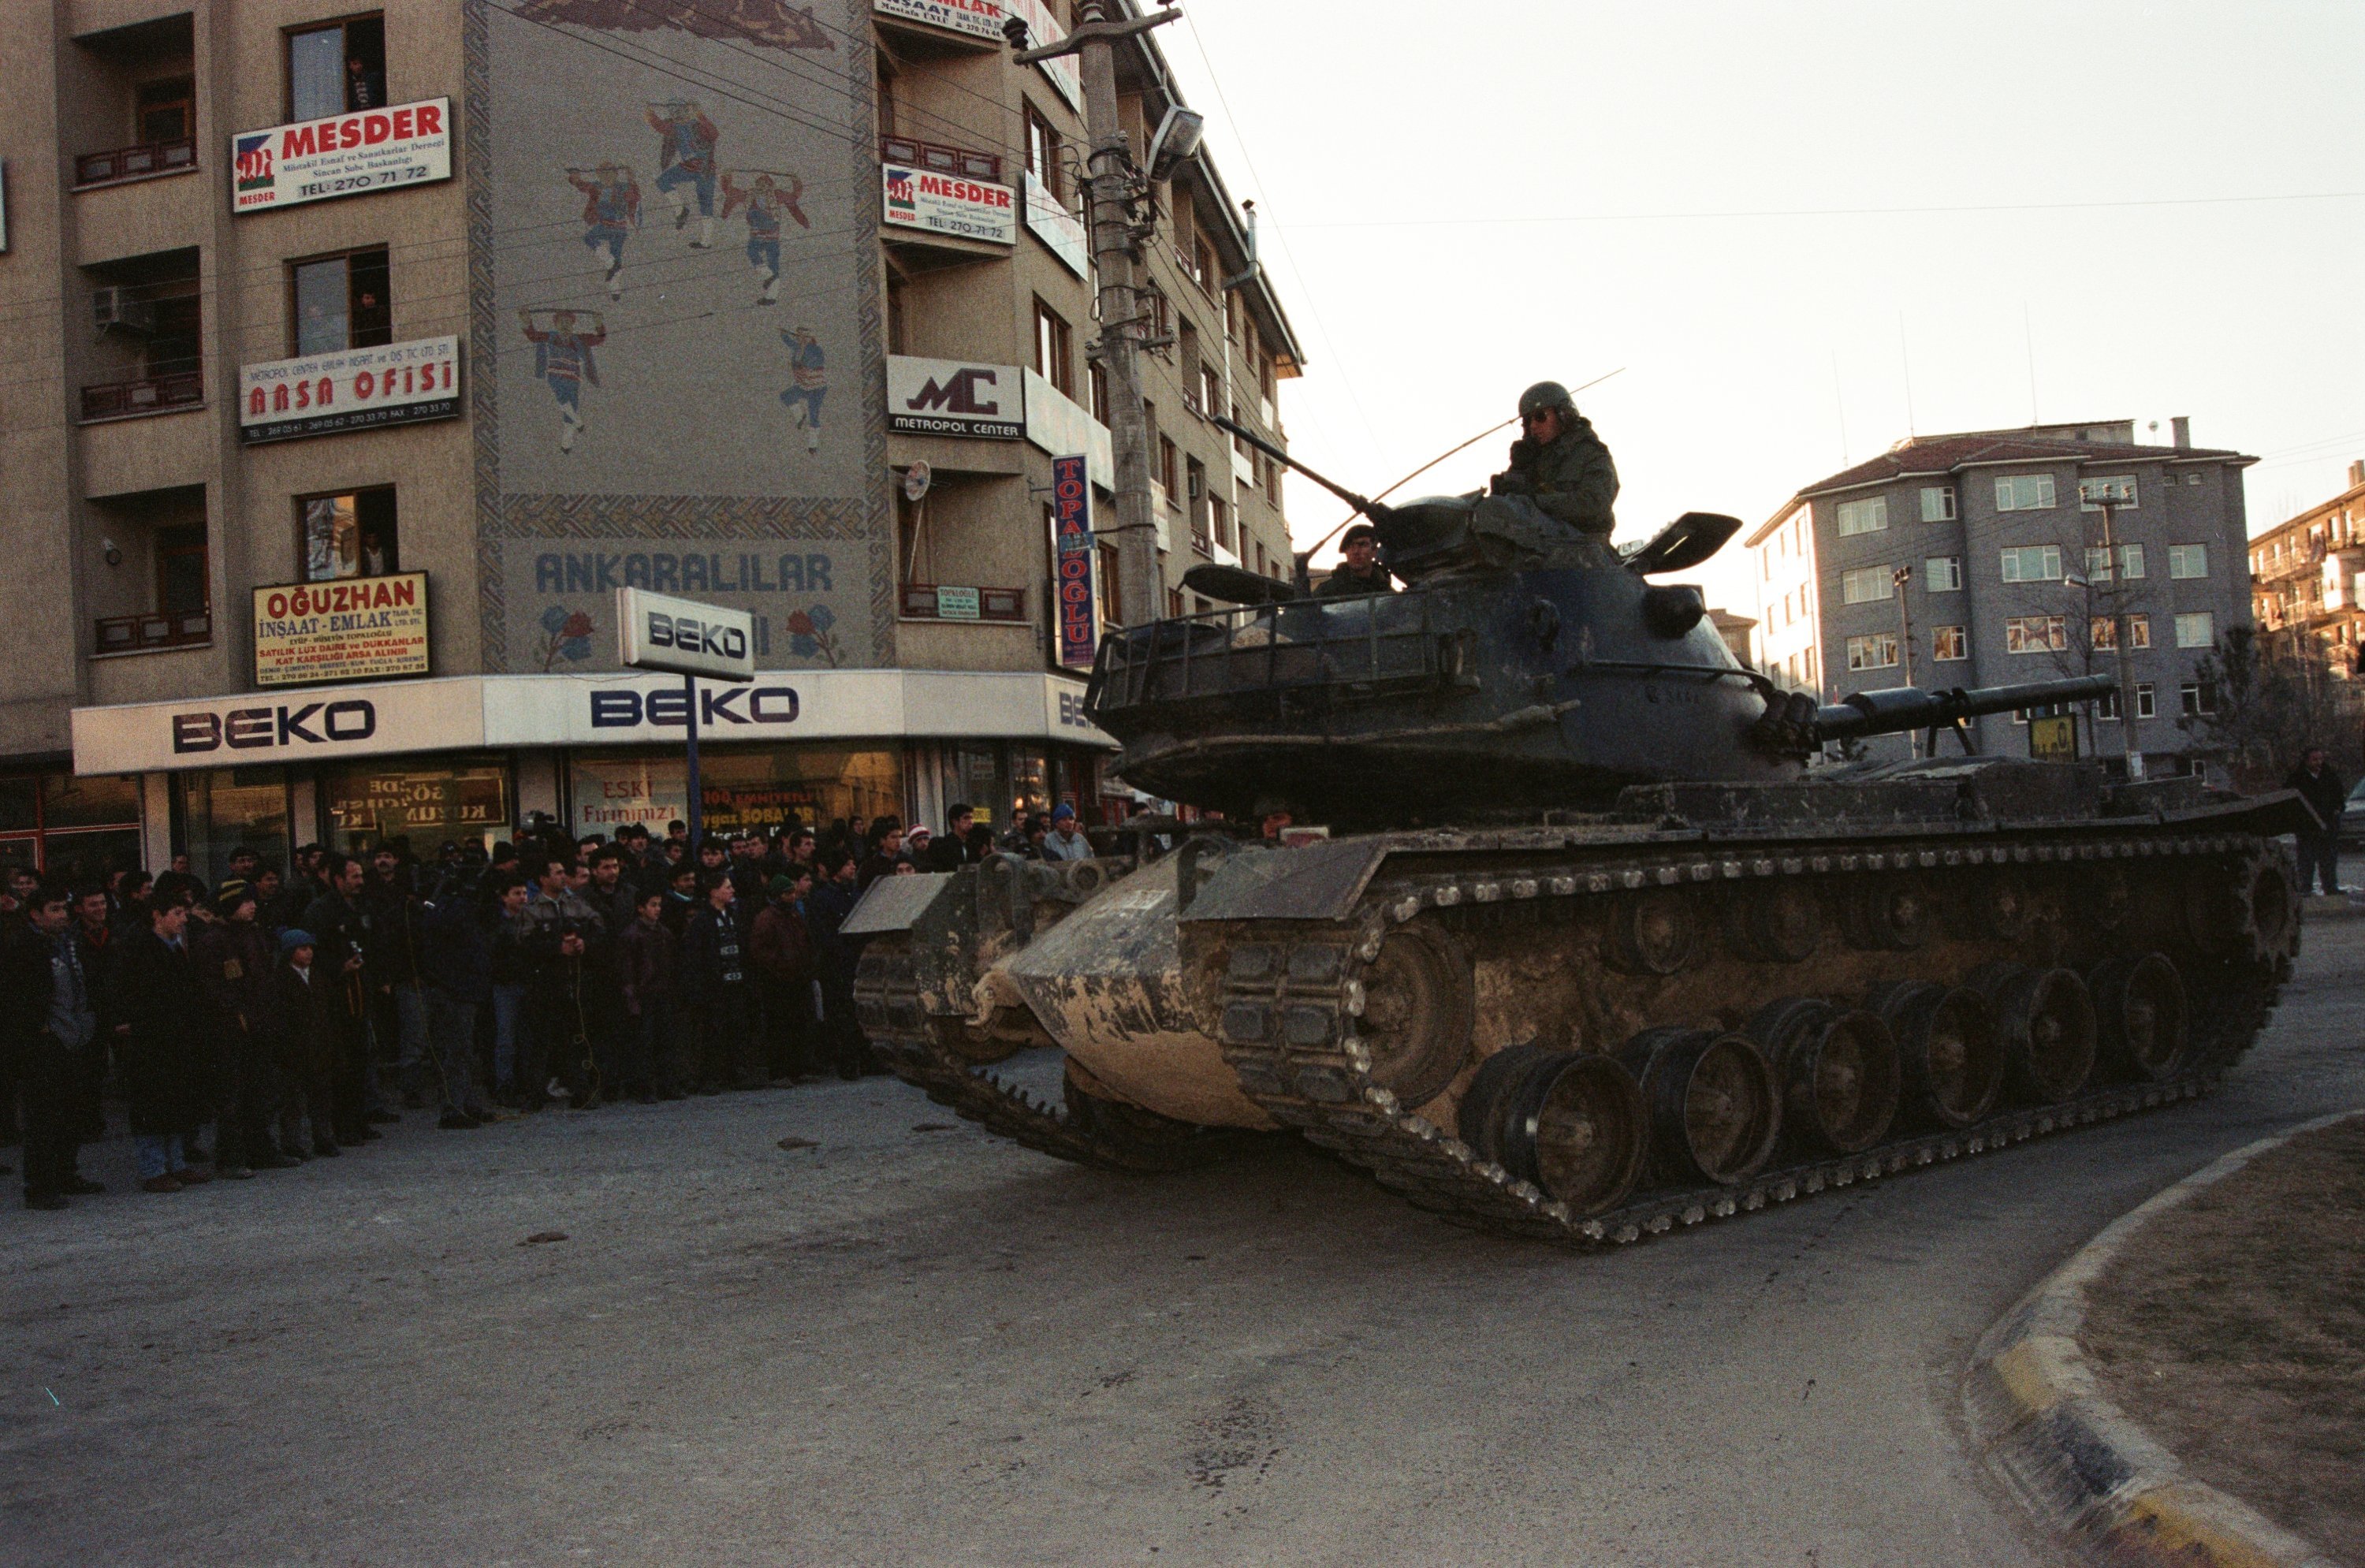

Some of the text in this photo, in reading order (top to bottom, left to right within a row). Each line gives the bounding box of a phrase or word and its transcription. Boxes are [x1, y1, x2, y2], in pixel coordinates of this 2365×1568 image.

[281, 106, 443, 160] MESDER
[334, 176, 371, 192] 270
[379, 171, 397, 184] 71
[406, 166, 426, 179] 72
[919, 175, 1011, 208] MESDER
[239, 192, 275, 206] MESDER
[888, 210, 916, 222] MESDER
[951, 221, 971, 233] 270
[977, 225, 986, 234] 71
[991, 228, 1003, 238] 72
[249, 377, 333, 417] ARSA
[367, 413, 376, 422] 33
[413, 405, 428, 415] 270
[441, 402, 450, 411] 70
[895, 417, 1019, 436] METROPOL CENTER
[535, 553, 832, 593] ANKARALILAR
[267, 579, 415, 620] OĞUZHAN
[259, 615, 319, 639] İNŞAAT
[330, 611, 393, 632] EMLAK
[647, 612, 747, 659] BEKO
[259, 647, 296, 657] SATILIK
[276, 657, 294, 665] KAT
[345, 650, 371, 659] ARSA
[590, 687, 799, 728] BEKO
[172, 699, 376, 754] BEKO
[602, 776, 653, 799] ESKİ
[701, 806, 814, 829] ygaz SOBAR
